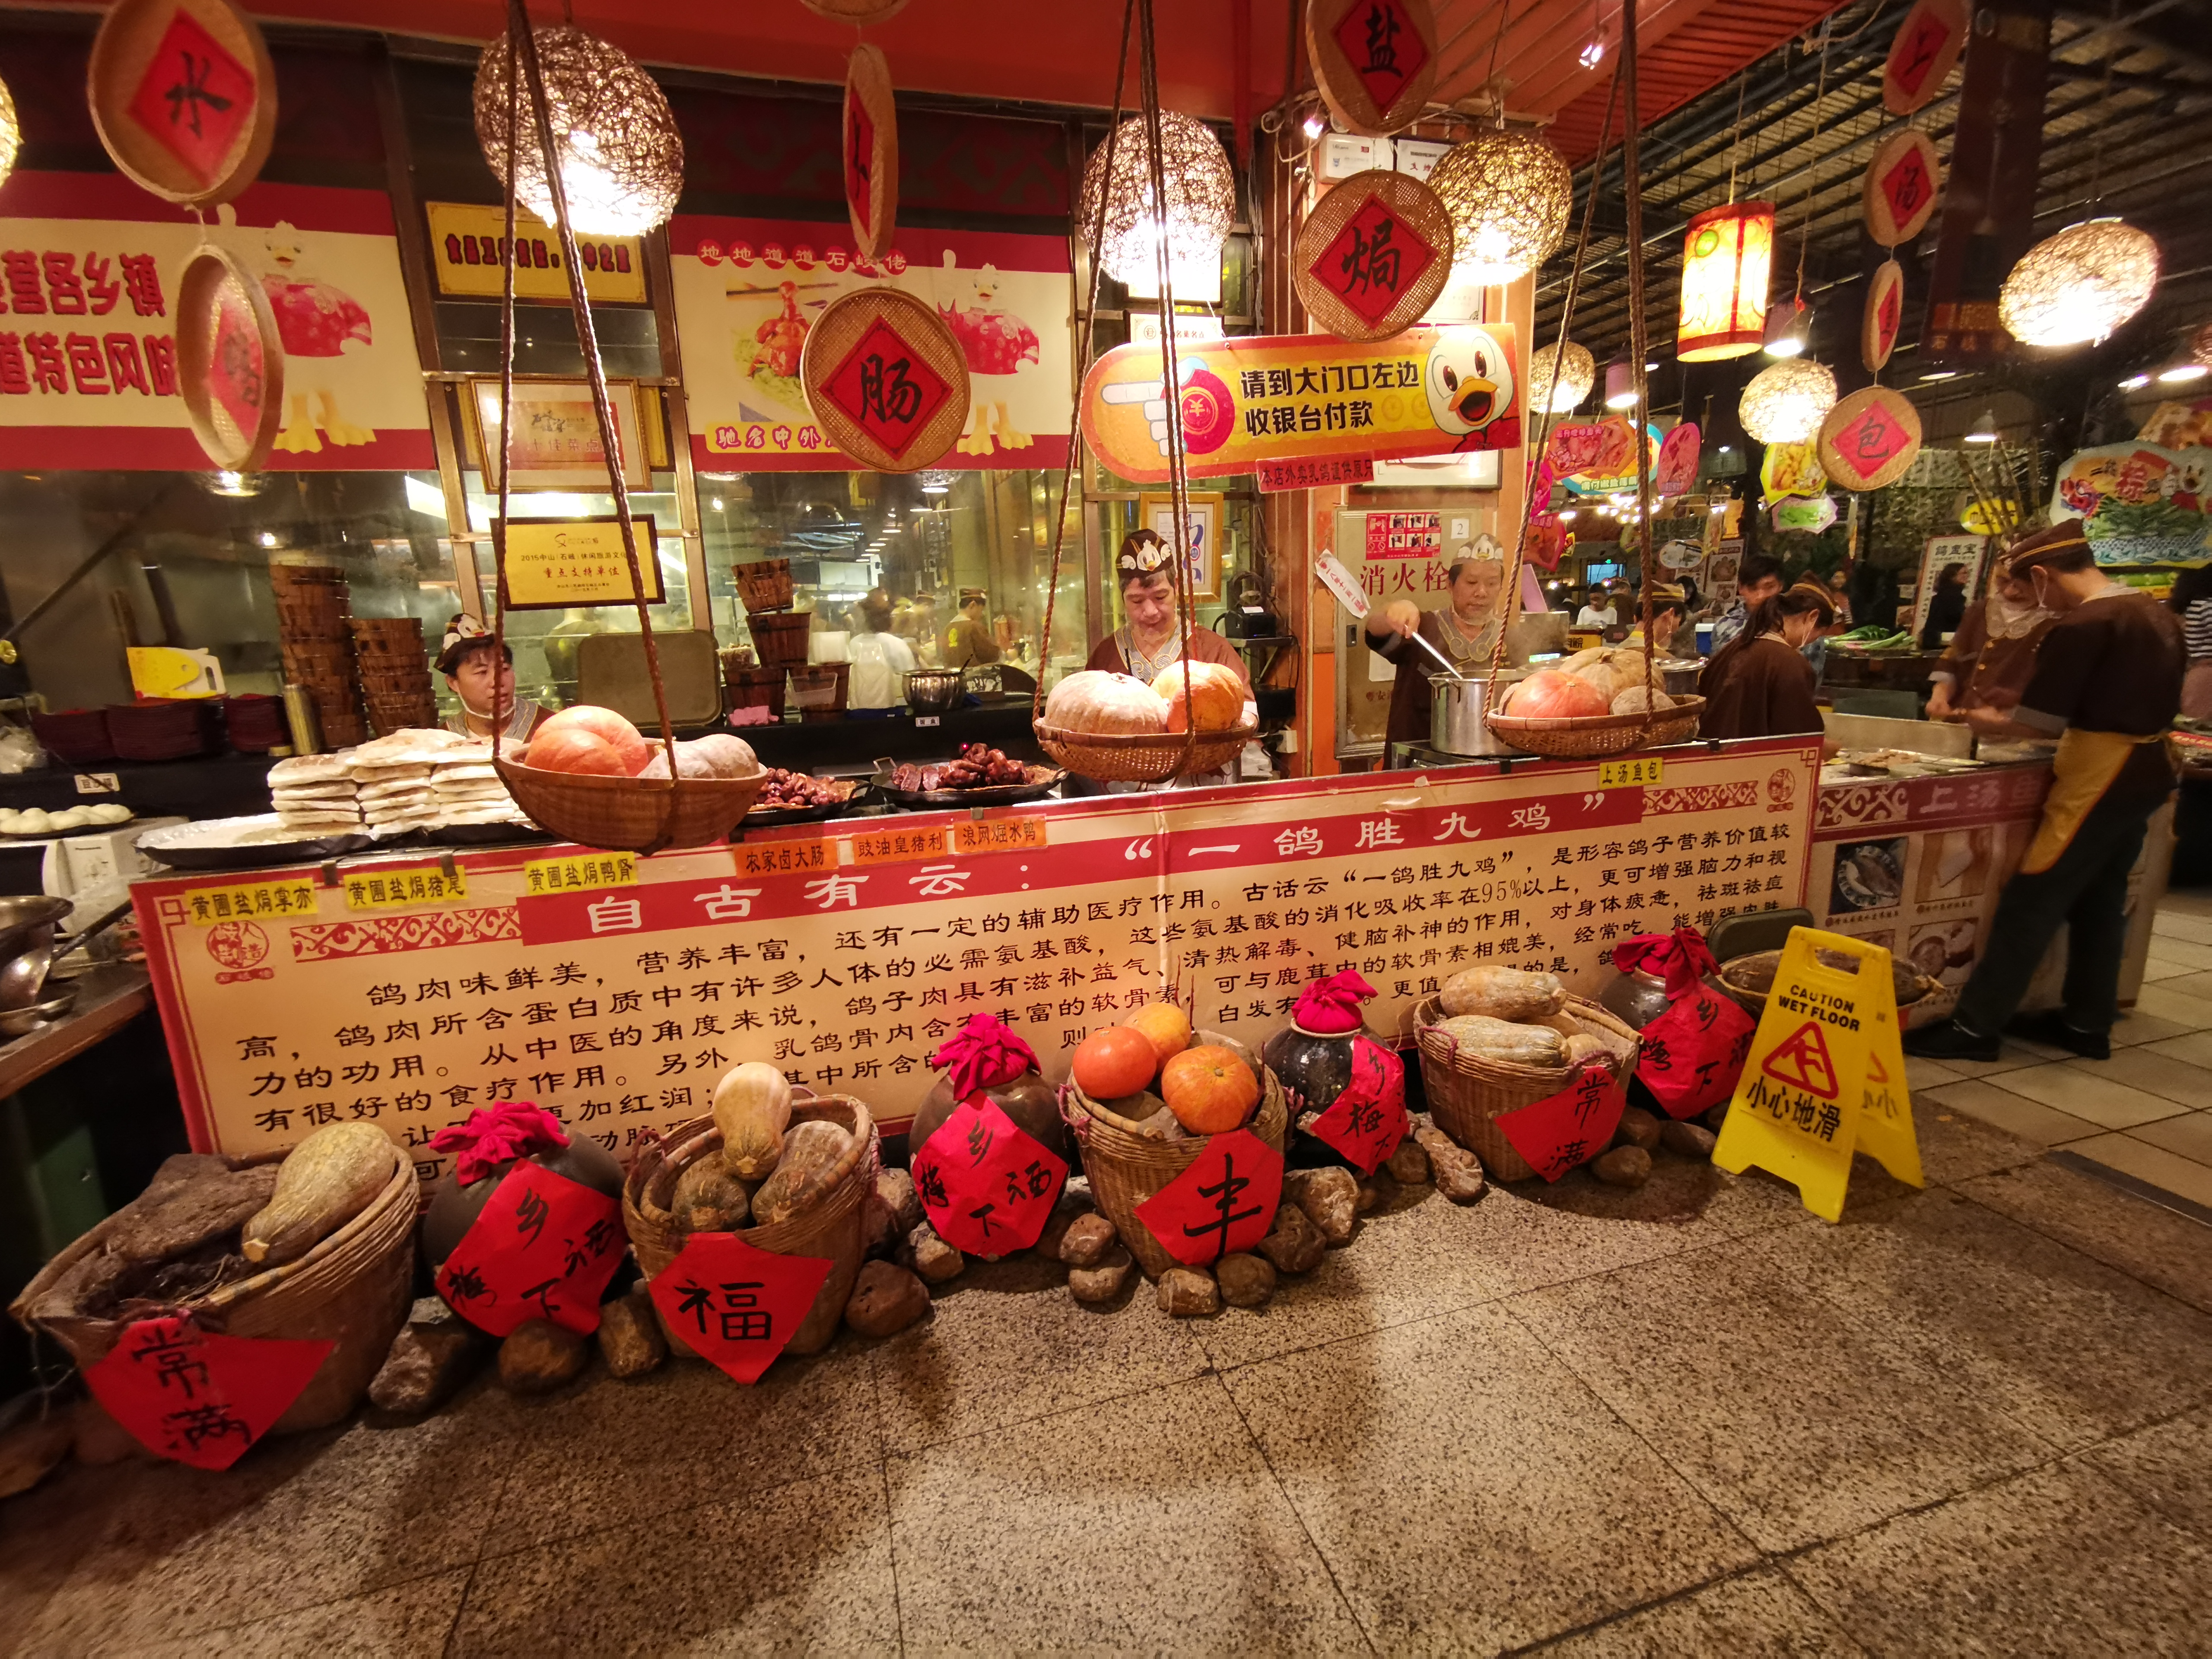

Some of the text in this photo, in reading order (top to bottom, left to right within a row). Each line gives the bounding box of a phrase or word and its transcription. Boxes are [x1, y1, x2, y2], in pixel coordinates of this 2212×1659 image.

[1361, 4, 1403, 78] 盐
[0, 250, 166, 317] 营各乡镇
[860, 353, 922, 424] 肠
[1240, 361, 1420, 399] 请到大门口左边
[1245, 401, 1374, 436] 收银台付款
[715, 426, 839, 450] 驰名中外
[1457, 523, 1463, 535] 2
[1360, 560, 1449, 596] 消火栓
[1778, 995, 1860, 1032] WET FLOOR
[1789, 983, 1855, 1014] CAUTION
[1746, 1075, 1840, 1143] 小心地滑
[1183, 1151, 1263, 1262] 丰
[674, 1279, 773, 1342] 福
